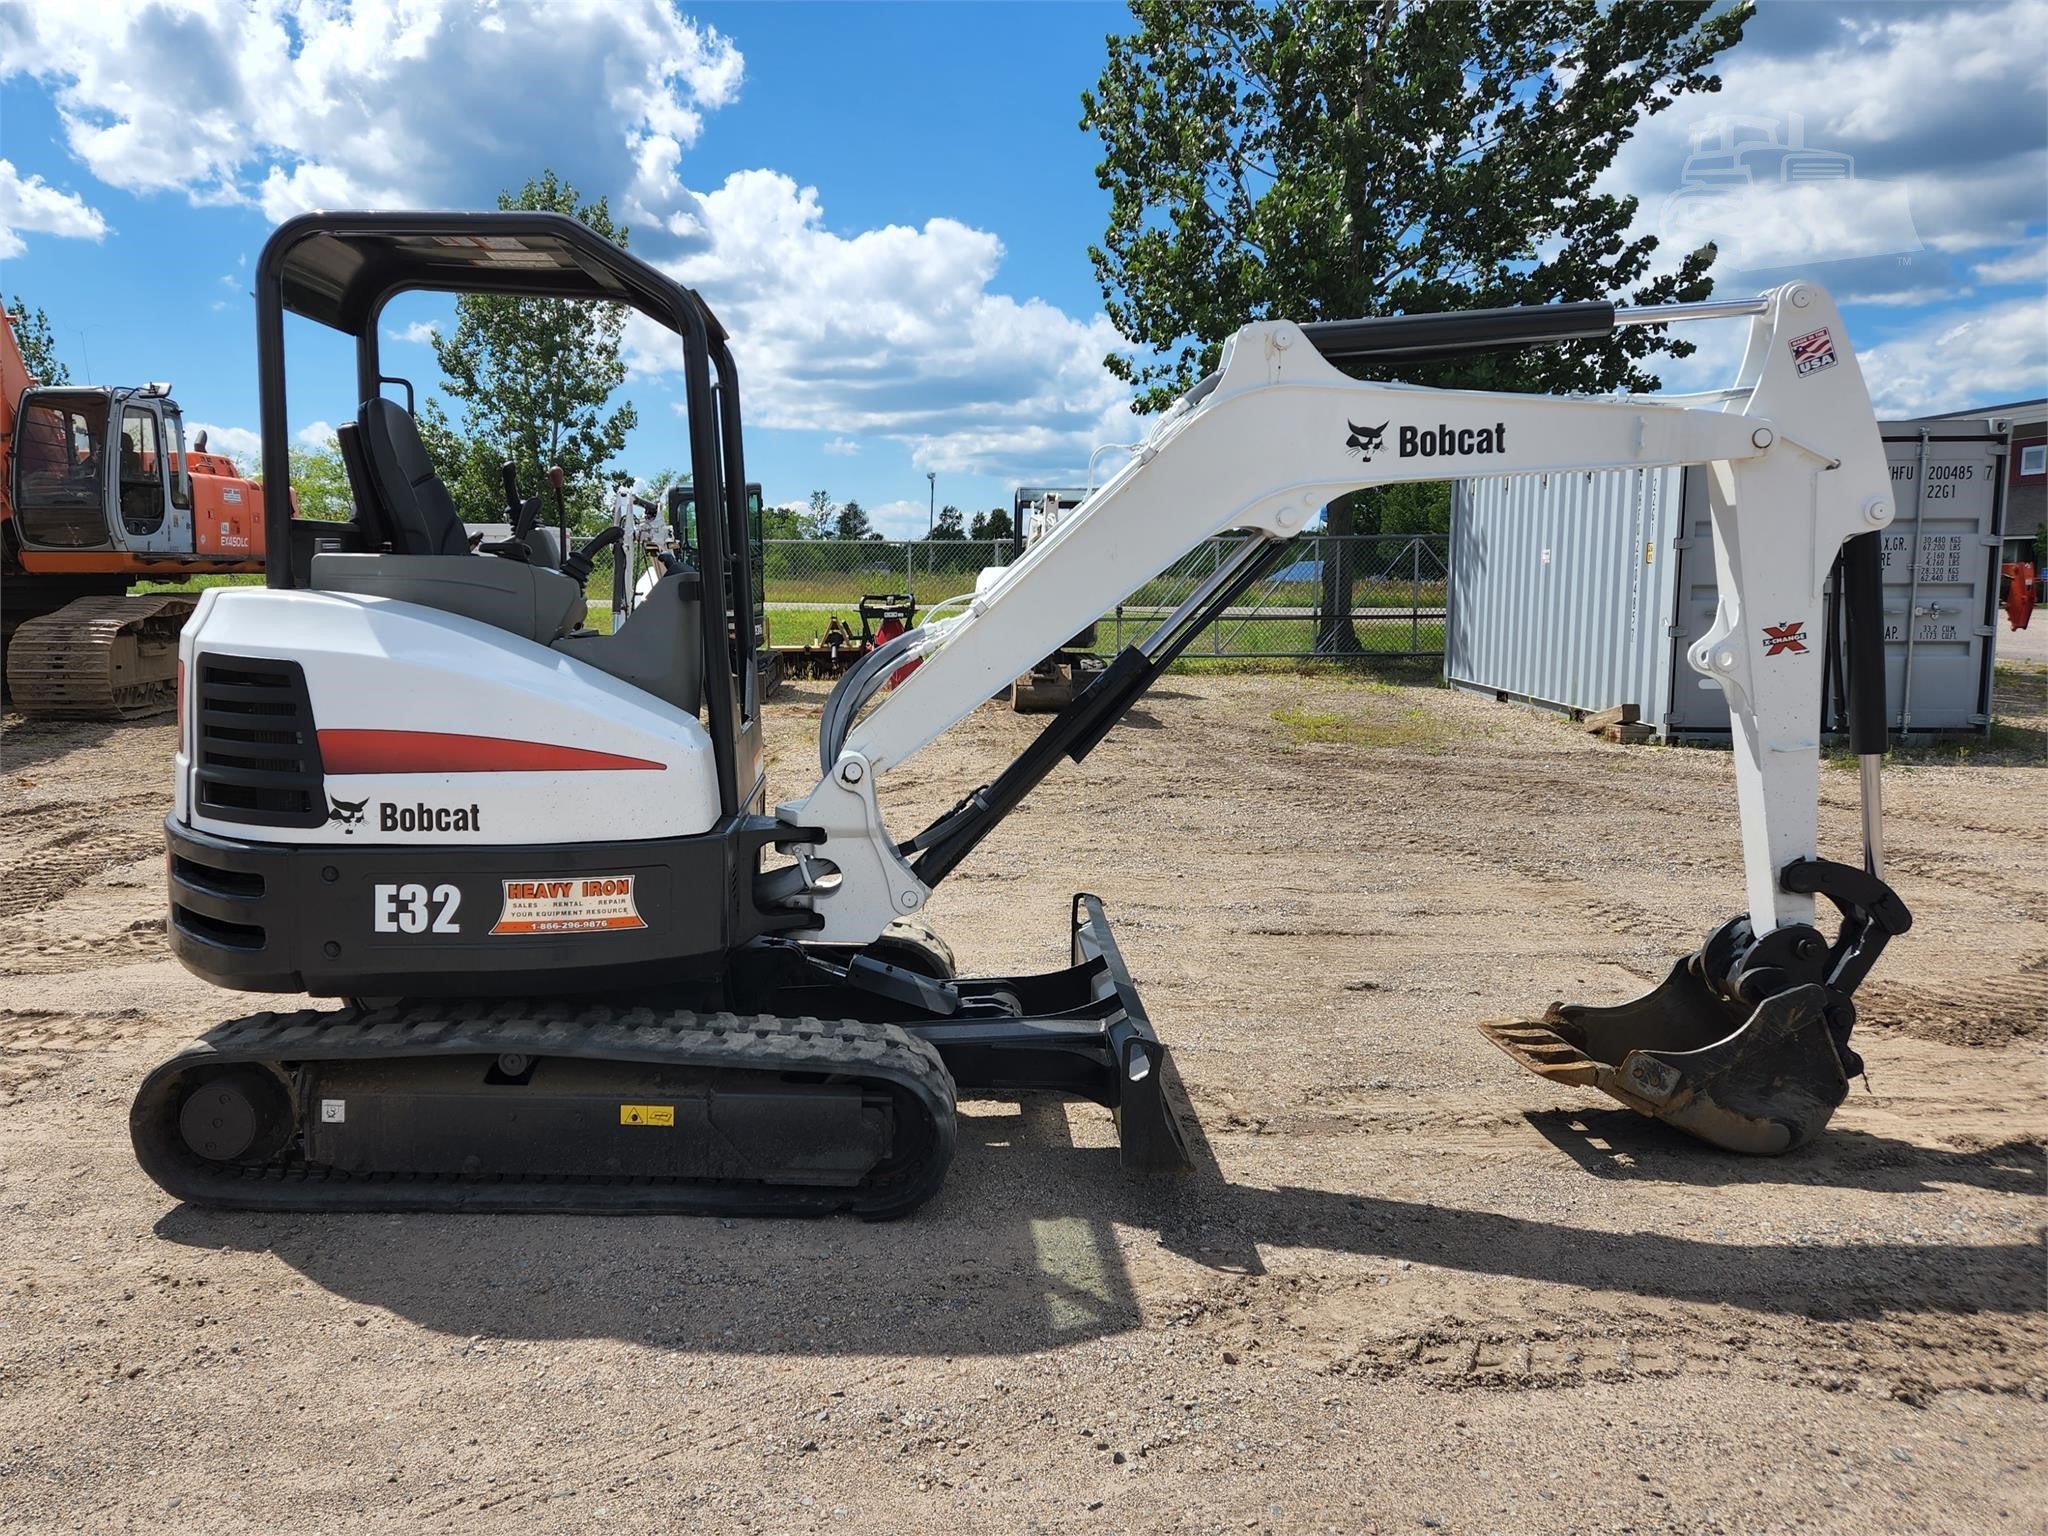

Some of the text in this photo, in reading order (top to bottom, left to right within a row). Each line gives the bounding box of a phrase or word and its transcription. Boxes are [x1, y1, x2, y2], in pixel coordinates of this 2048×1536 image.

[1799, 354, 1834, 373] USA
[1399, 422, 1506, 458] Bobcat
[1887, 465, 1994, 480] HFU 200485 7
[1927, 484, 1956, 498] 22G1
[1949, 543, 1961, 551] LBS
[1880, 552, 1892, 566] RE
[1948, 559, 1960, 567] LBS
[1947, 567, 1959, 575] KGS
[1947, 574, 1959, 582] LBS
[1884, 625, 1899, 639] AP.
[1763, 633, 1807, 647] X-CHANGE
[379, 802, 481, 831] Bobcat
[508, 879, 629, 899] HEAVY IRON
[374, 883, 462, 934] E32
[536, 909, 582, 917] EQUIPMENT
[586, 907, 628, 915] RESOURCE
[531, 919, 608, 931] 1-866-296-9876
